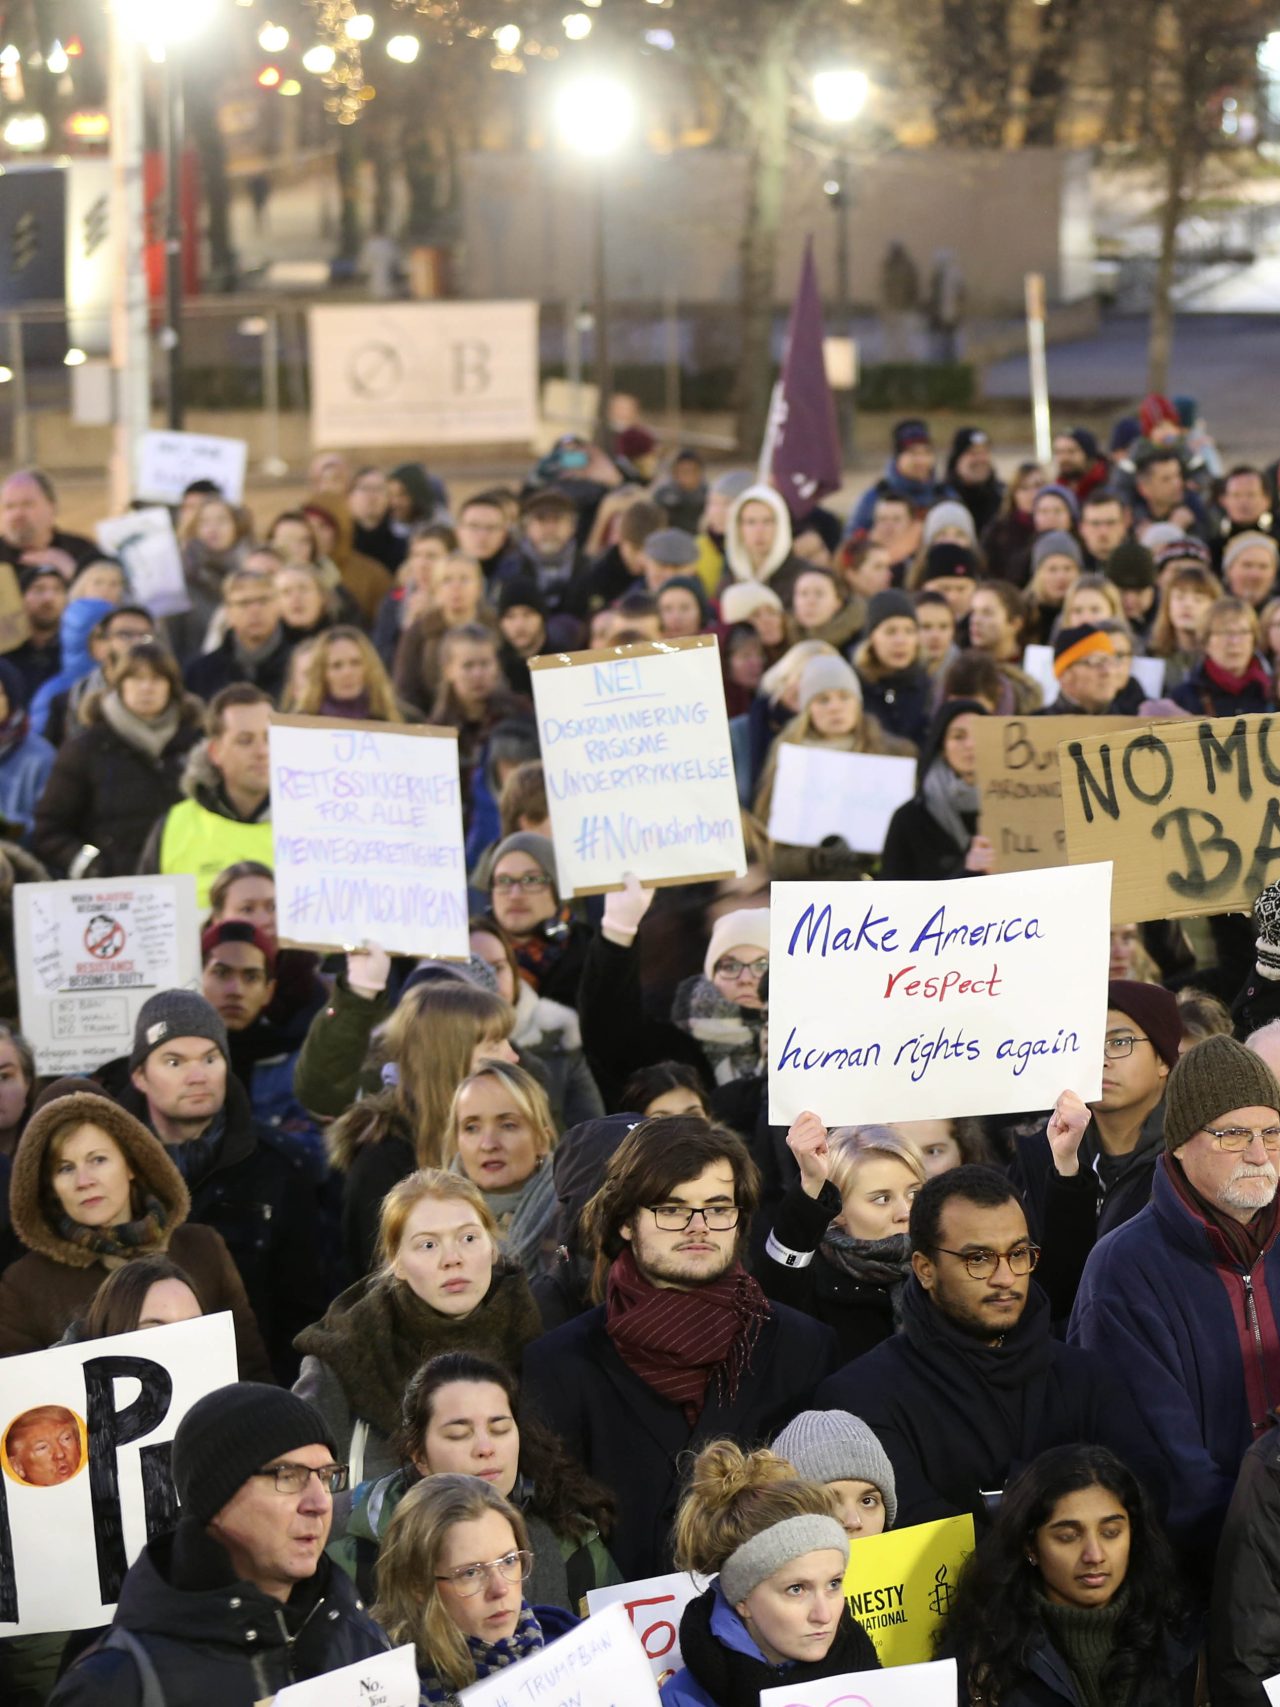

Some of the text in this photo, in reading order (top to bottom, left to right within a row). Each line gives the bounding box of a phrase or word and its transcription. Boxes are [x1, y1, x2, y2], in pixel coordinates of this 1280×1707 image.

[330, 732, 381, 763] JA
[583, 732, 669, 766] RASISME
[547, 755, 731, 801] UNDERTRYKKELSE
[1067, 733, 1175, 824] NO
[314, 800, 428, 828] FOR ALLE
[787, 902, 1046, 957] Make America
[69, 972, 145, 987] BECOMES DUTY
[75, 960, 136, 974] RESISTANCE
[882, 963, 1003, 1002] respect
[777, 1027, 1081, 1082] human rights again
[845, 1584, 904, 1617] NESTY
